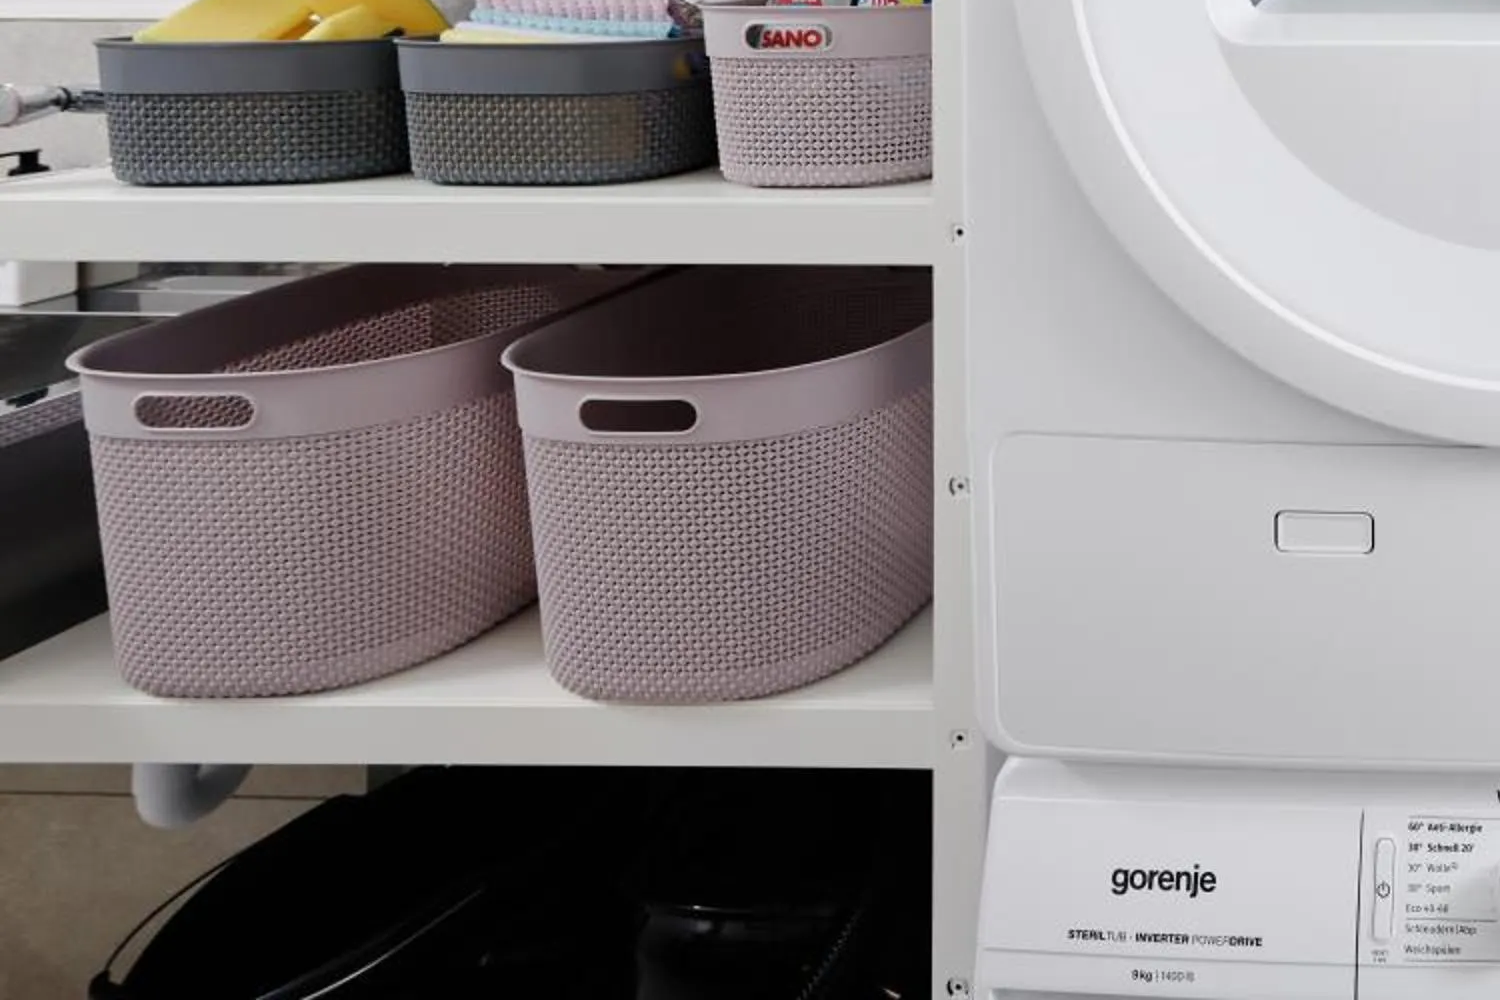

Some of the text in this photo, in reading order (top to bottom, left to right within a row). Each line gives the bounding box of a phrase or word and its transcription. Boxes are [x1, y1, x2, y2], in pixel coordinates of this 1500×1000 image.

[762, 31, 821, 48] SANO
[1110, 864, 1217, 898] gorenje
[1067, 929, 1263, 947] STERILTUB INVERTER POWERDRIVE
